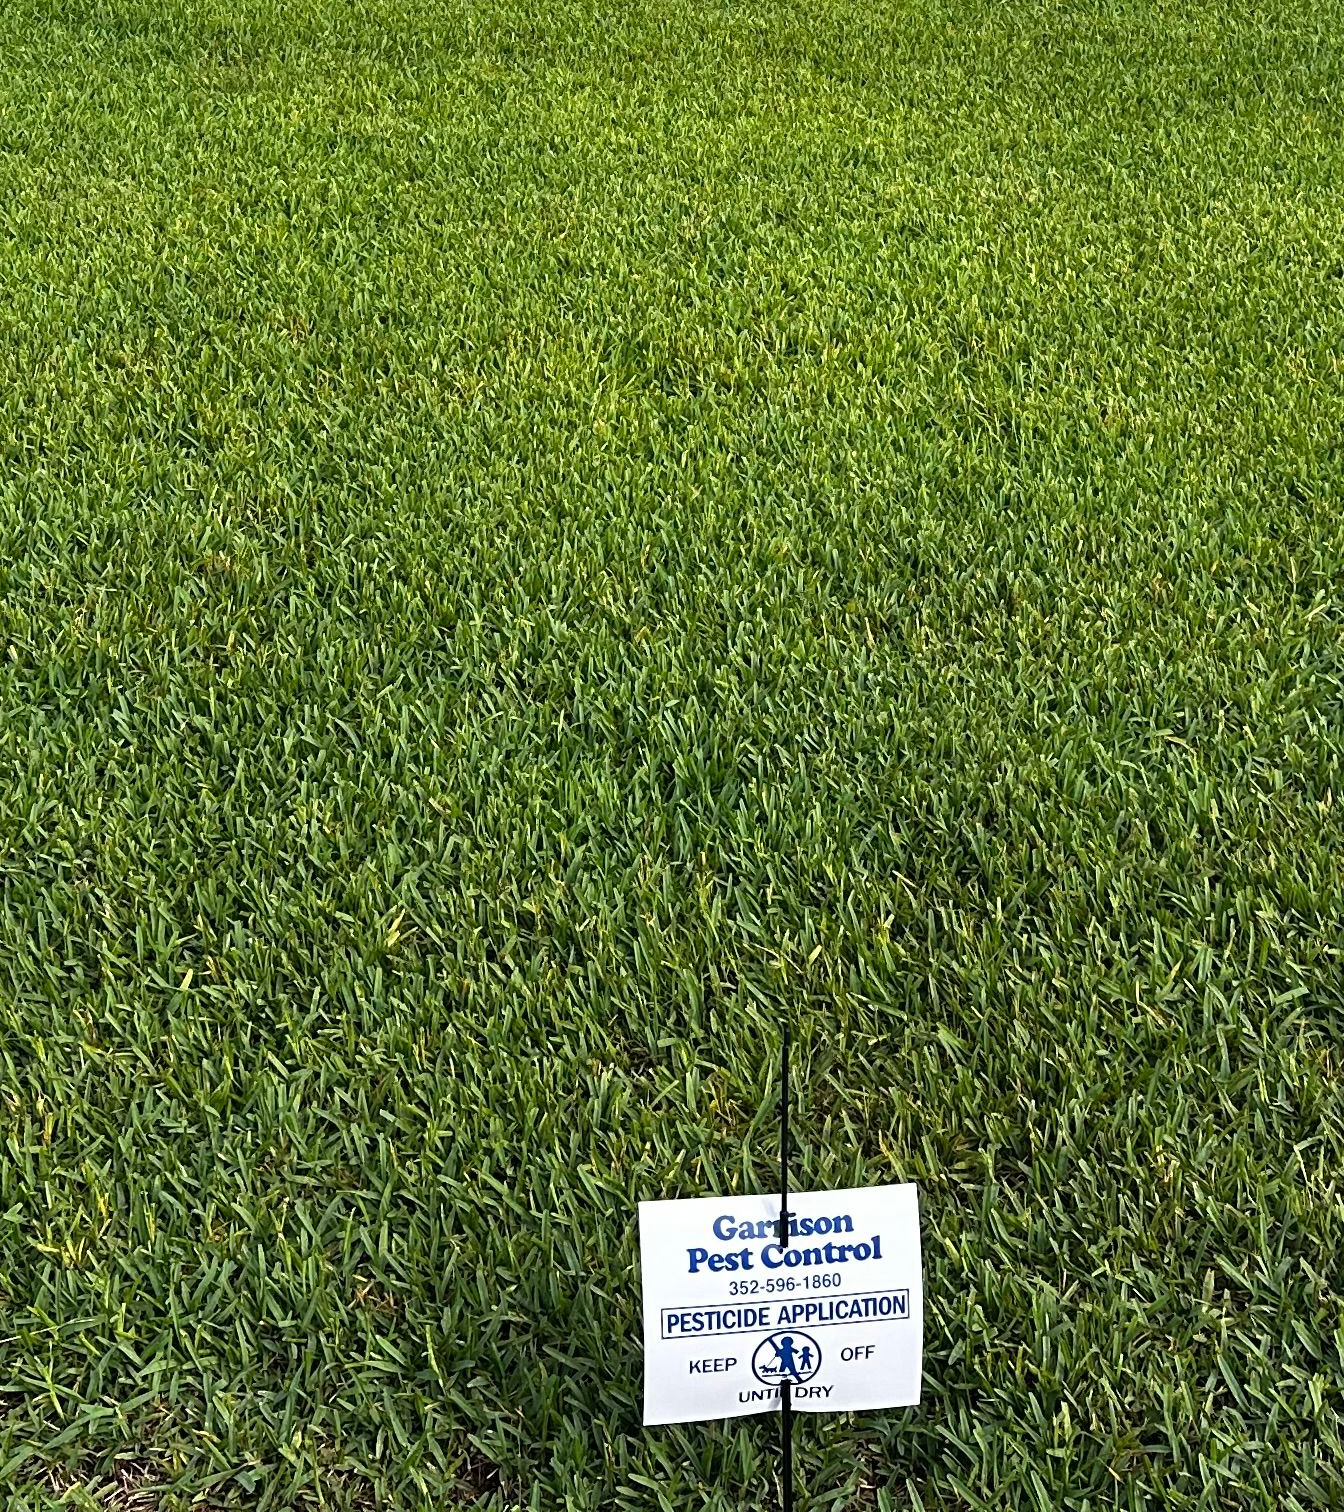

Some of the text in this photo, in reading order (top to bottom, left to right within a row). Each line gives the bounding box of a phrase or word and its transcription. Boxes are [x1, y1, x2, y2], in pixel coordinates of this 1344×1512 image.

[686, 1235, 883, 1273] Pest Control
[729, 1272, 841, 1296] 352-596-1860
[667, 1295, 905, 1334] PESTICIDE APPLICATION
[689, 1345, 876, 1374] KEEP OFF
[739, 1385, 835, 1403] UNTI DRY
